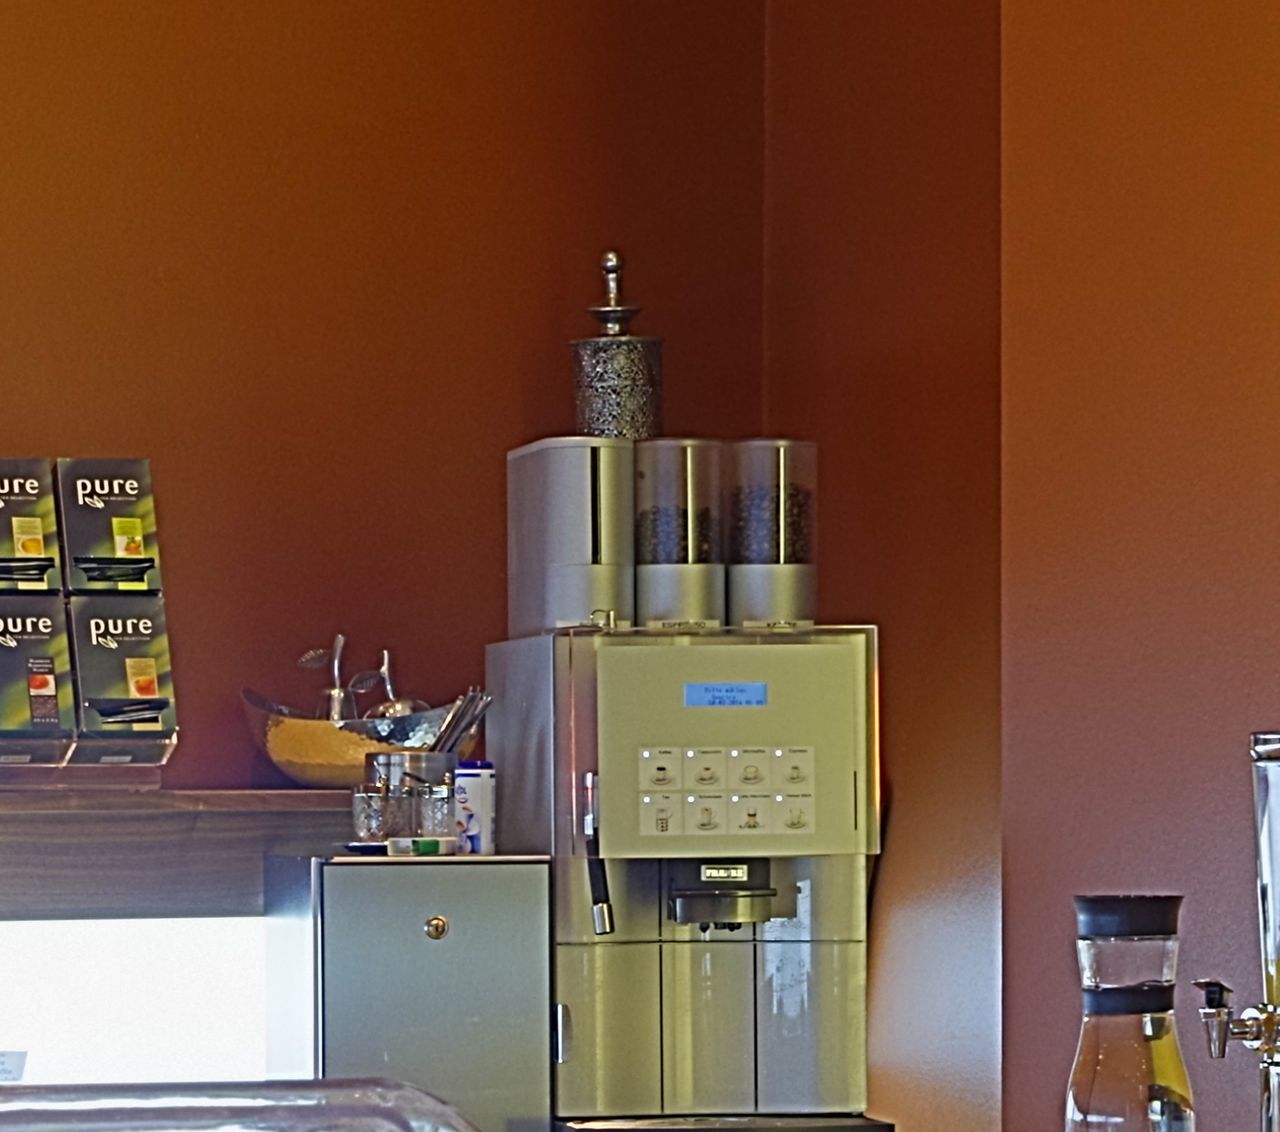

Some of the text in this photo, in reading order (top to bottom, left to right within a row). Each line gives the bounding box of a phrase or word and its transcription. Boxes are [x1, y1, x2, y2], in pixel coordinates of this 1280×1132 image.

[76, 479, 139, 505] pure
[90, 618, 152, 645] pure
[705, 869, 743, 877] FRAKE
